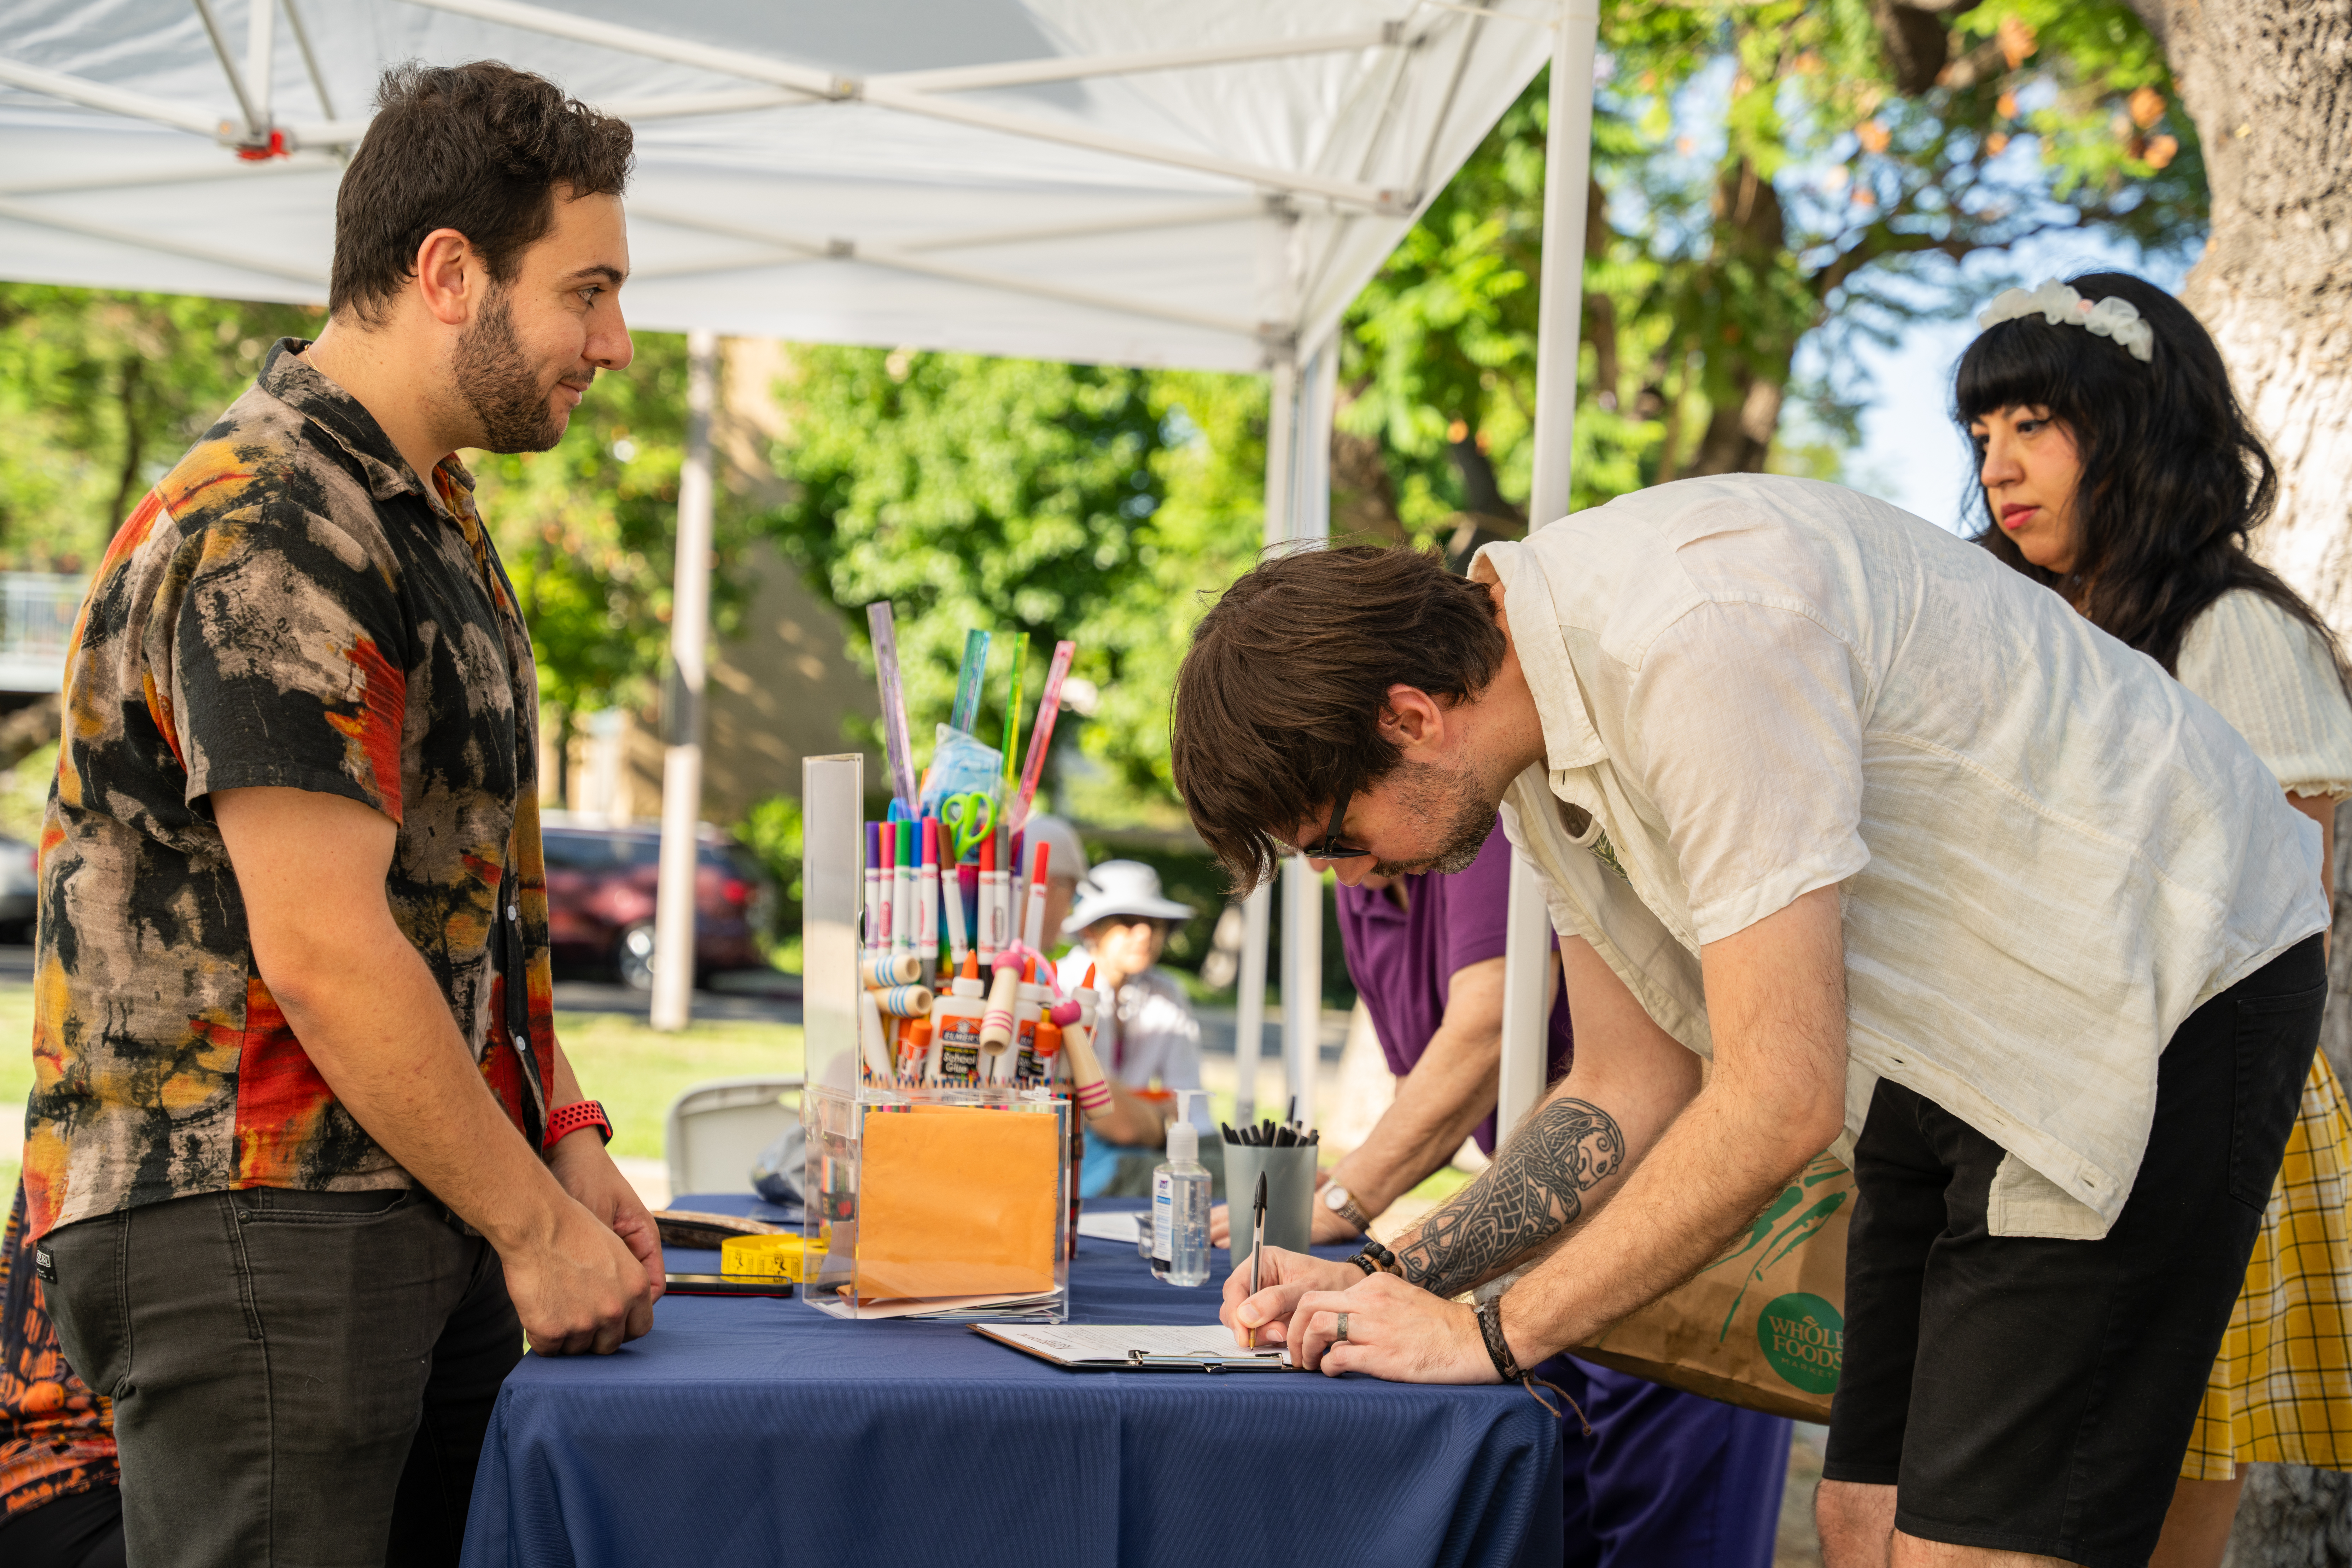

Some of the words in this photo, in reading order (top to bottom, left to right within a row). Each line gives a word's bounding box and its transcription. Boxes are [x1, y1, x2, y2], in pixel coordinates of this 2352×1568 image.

[943, 1051, 977, 1065] School
[945, 1061, 969, 1074] Glue
[1768, 1315, 1843, 1349] WHOLE
[1773, 1334, 1843, 1371] FOODS
[1781, 1357, 1833, 1379] MARKET
